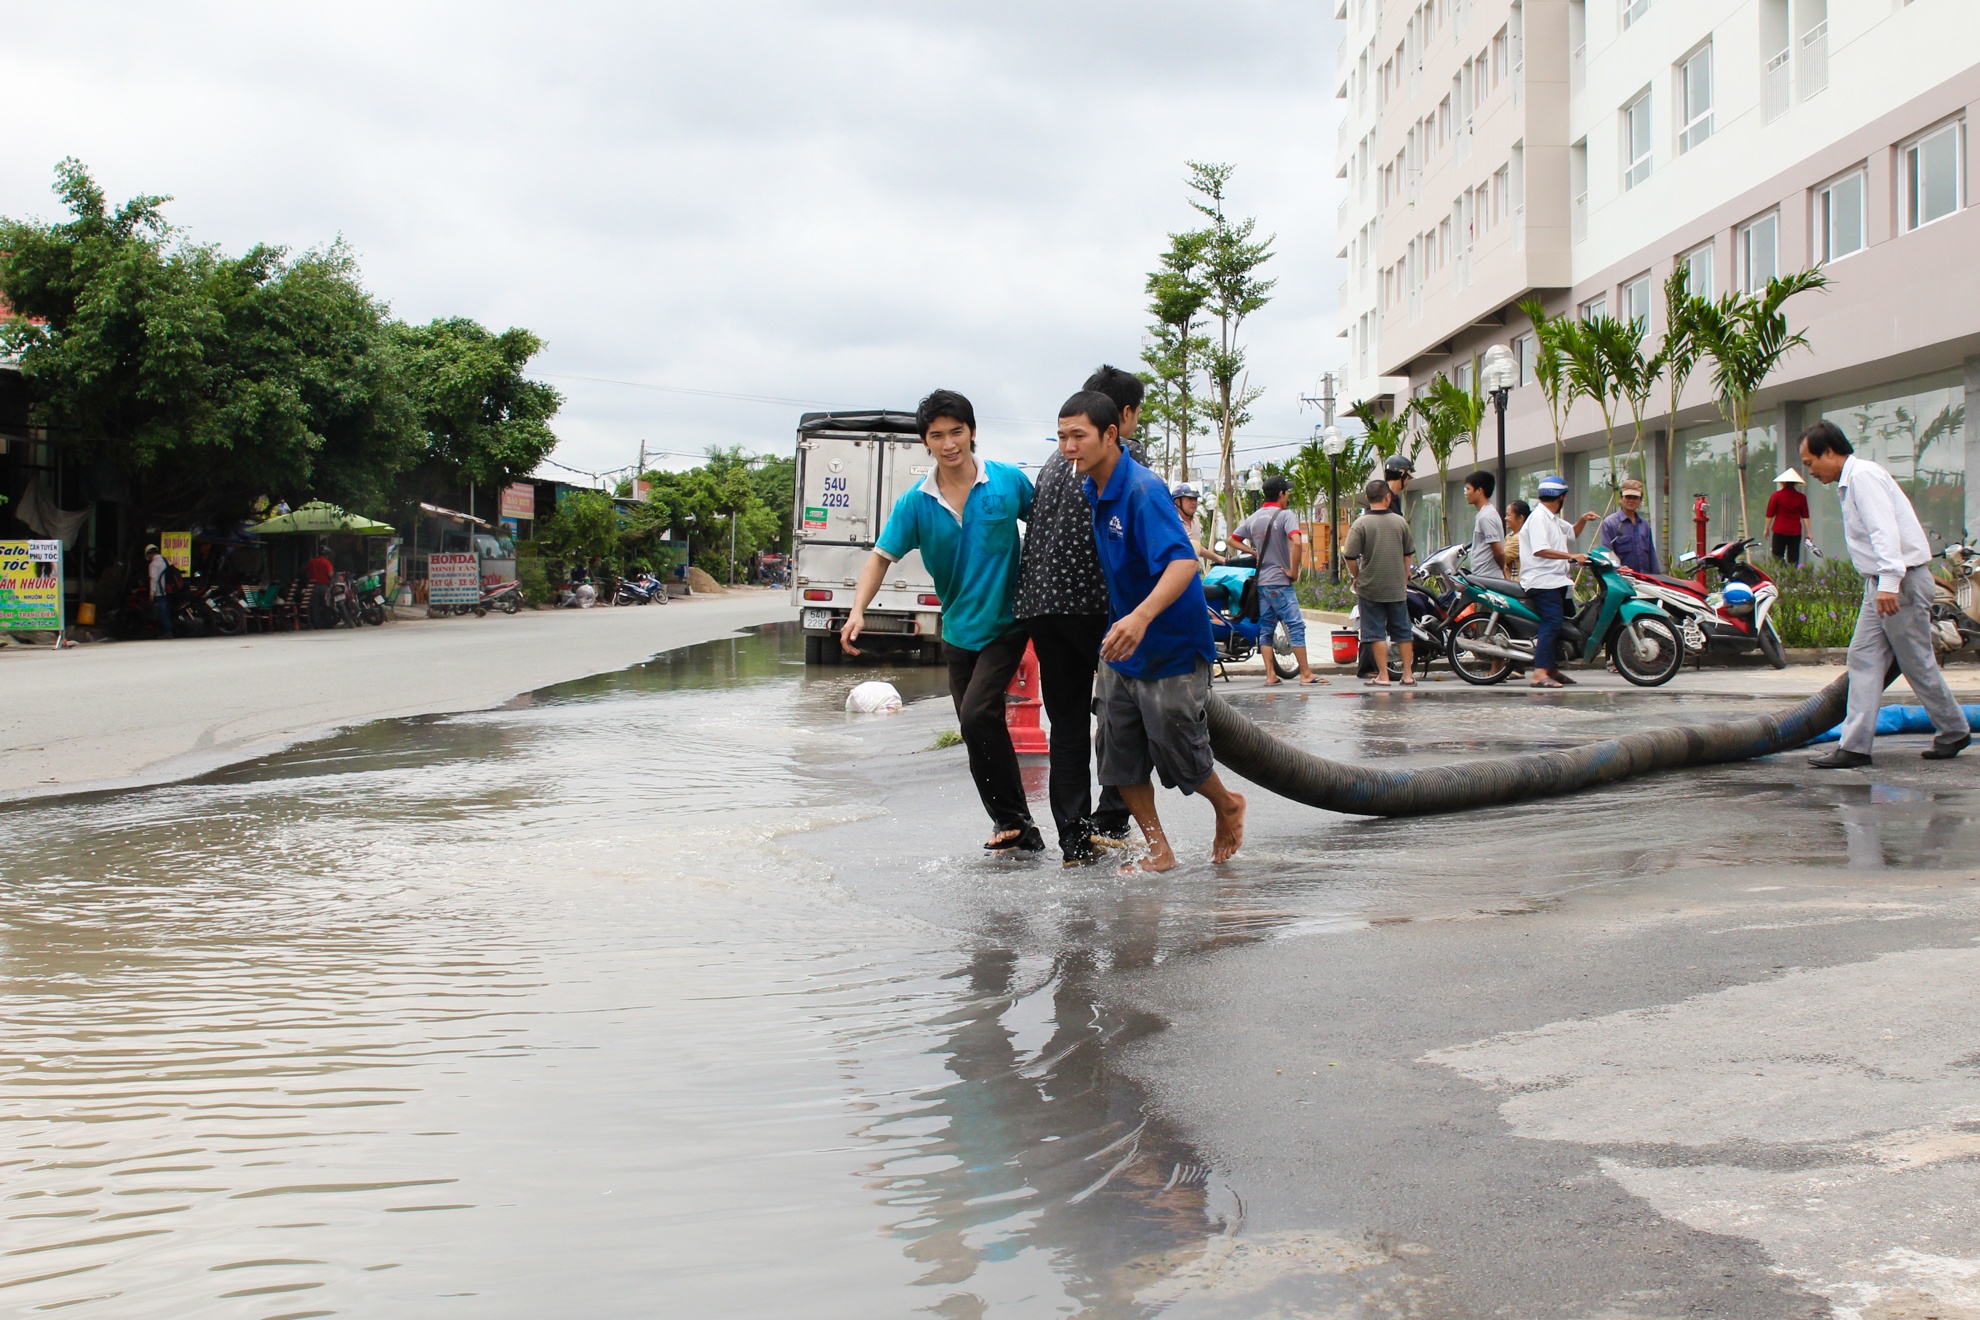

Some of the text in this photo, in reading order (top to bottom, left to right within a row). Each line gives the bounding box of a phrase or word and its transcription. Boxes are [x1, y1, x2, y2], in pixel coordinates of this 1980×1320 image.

[824, 477, 846, 491] 54U
[822, 493, 850, 508] 2292
[3, 558, 29, 571] TÓC
[430, 554, 477, 564] HONDA
[20, 578, 56, 589] NHUNG
[810, 611, 827, 619] 54U
